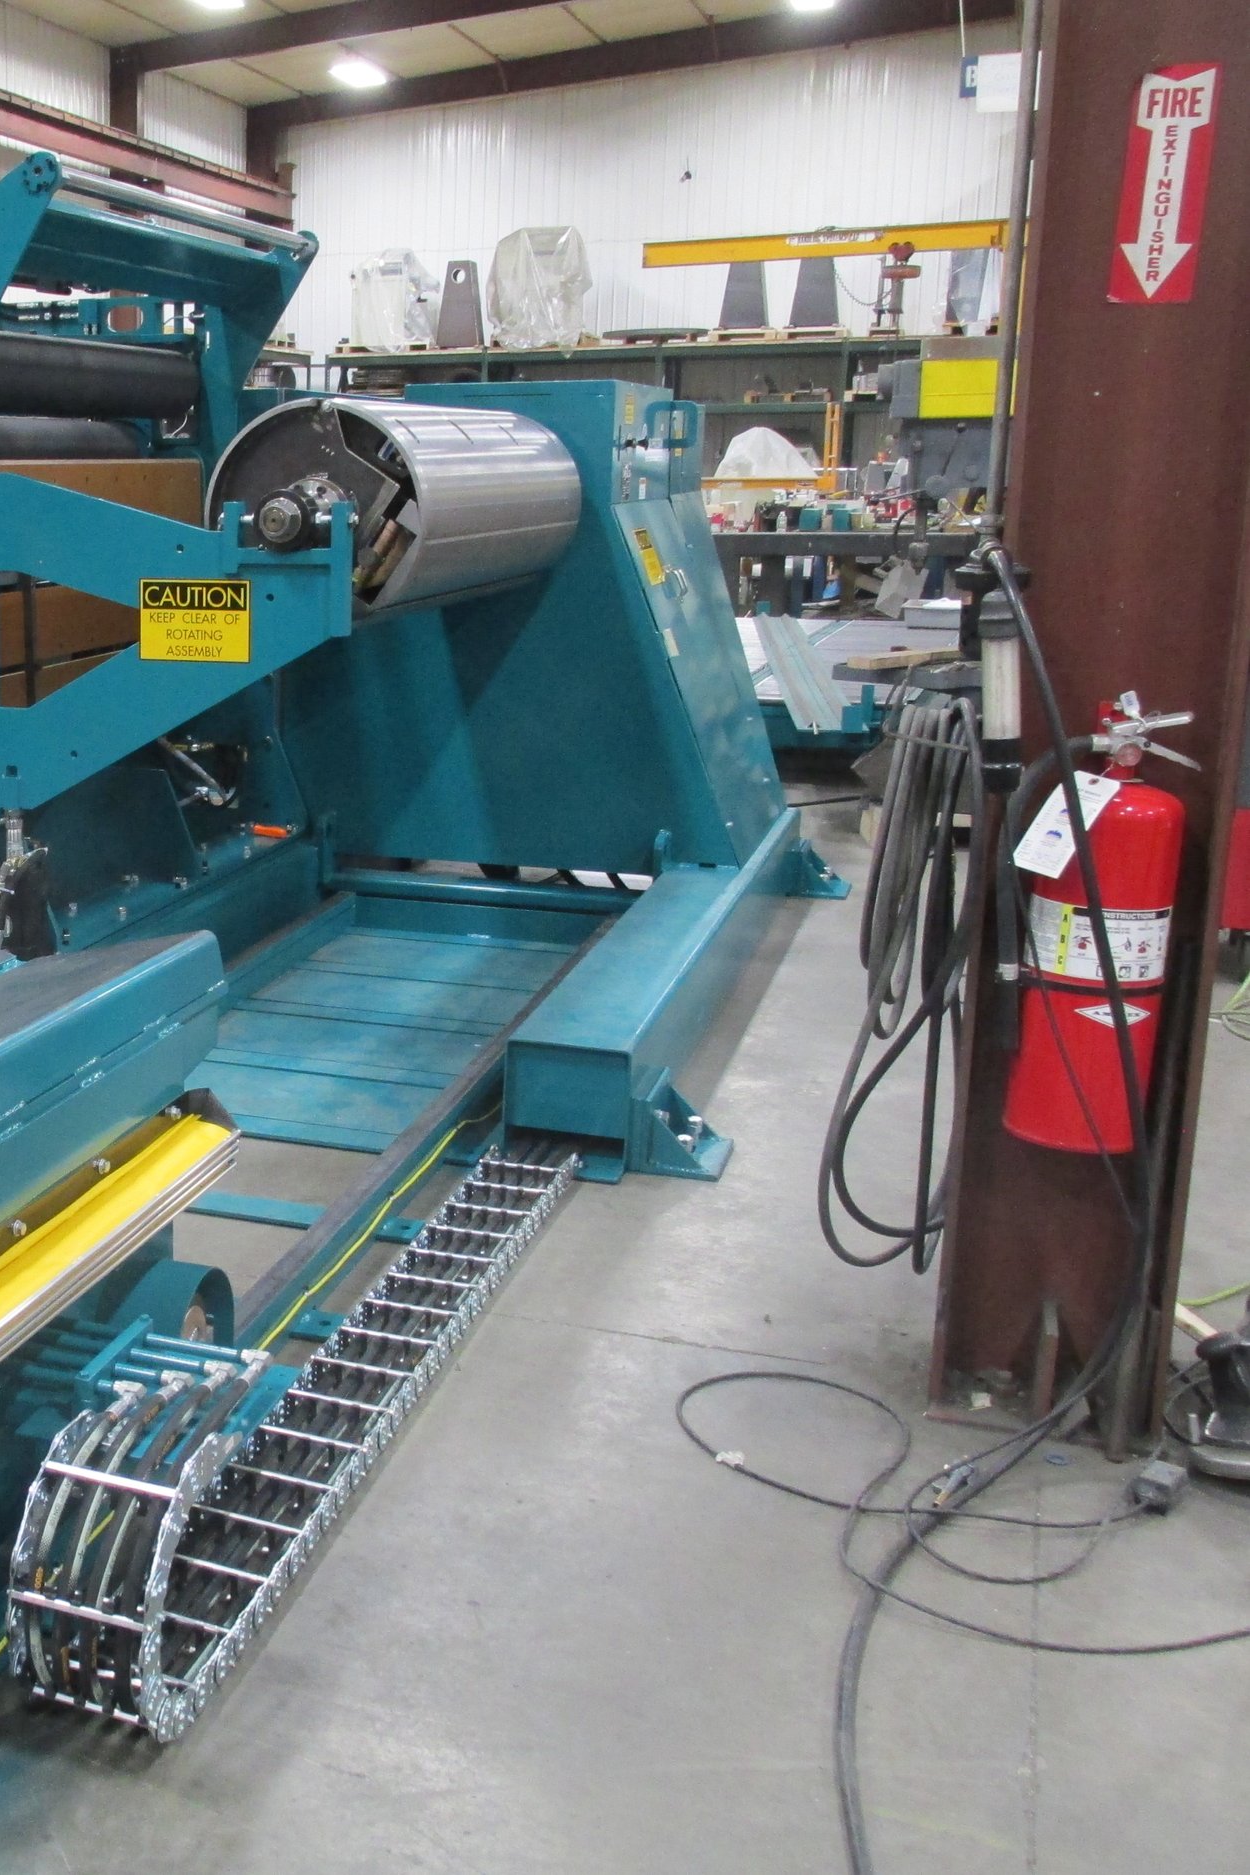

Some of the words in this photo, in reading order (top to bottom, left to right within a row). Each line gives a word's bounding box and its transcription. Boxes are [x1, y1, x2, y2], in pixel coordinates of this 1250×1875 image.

[1146, 86, 1205, 119] FIRE
[1145, 124, 1179, 282] EXTINGUISHER
[144, 585, 245, 609] CAUTION
[149, 612, 176, 624] KEEP
[181, 612, 217, 625] CLEAR
[223, 613, 241, 625] OF
[165, 628, 223, 641] ROTATING
[165, 645, 223, 658] ASSEMBLY
[1062, 914, 1068, 923] A
